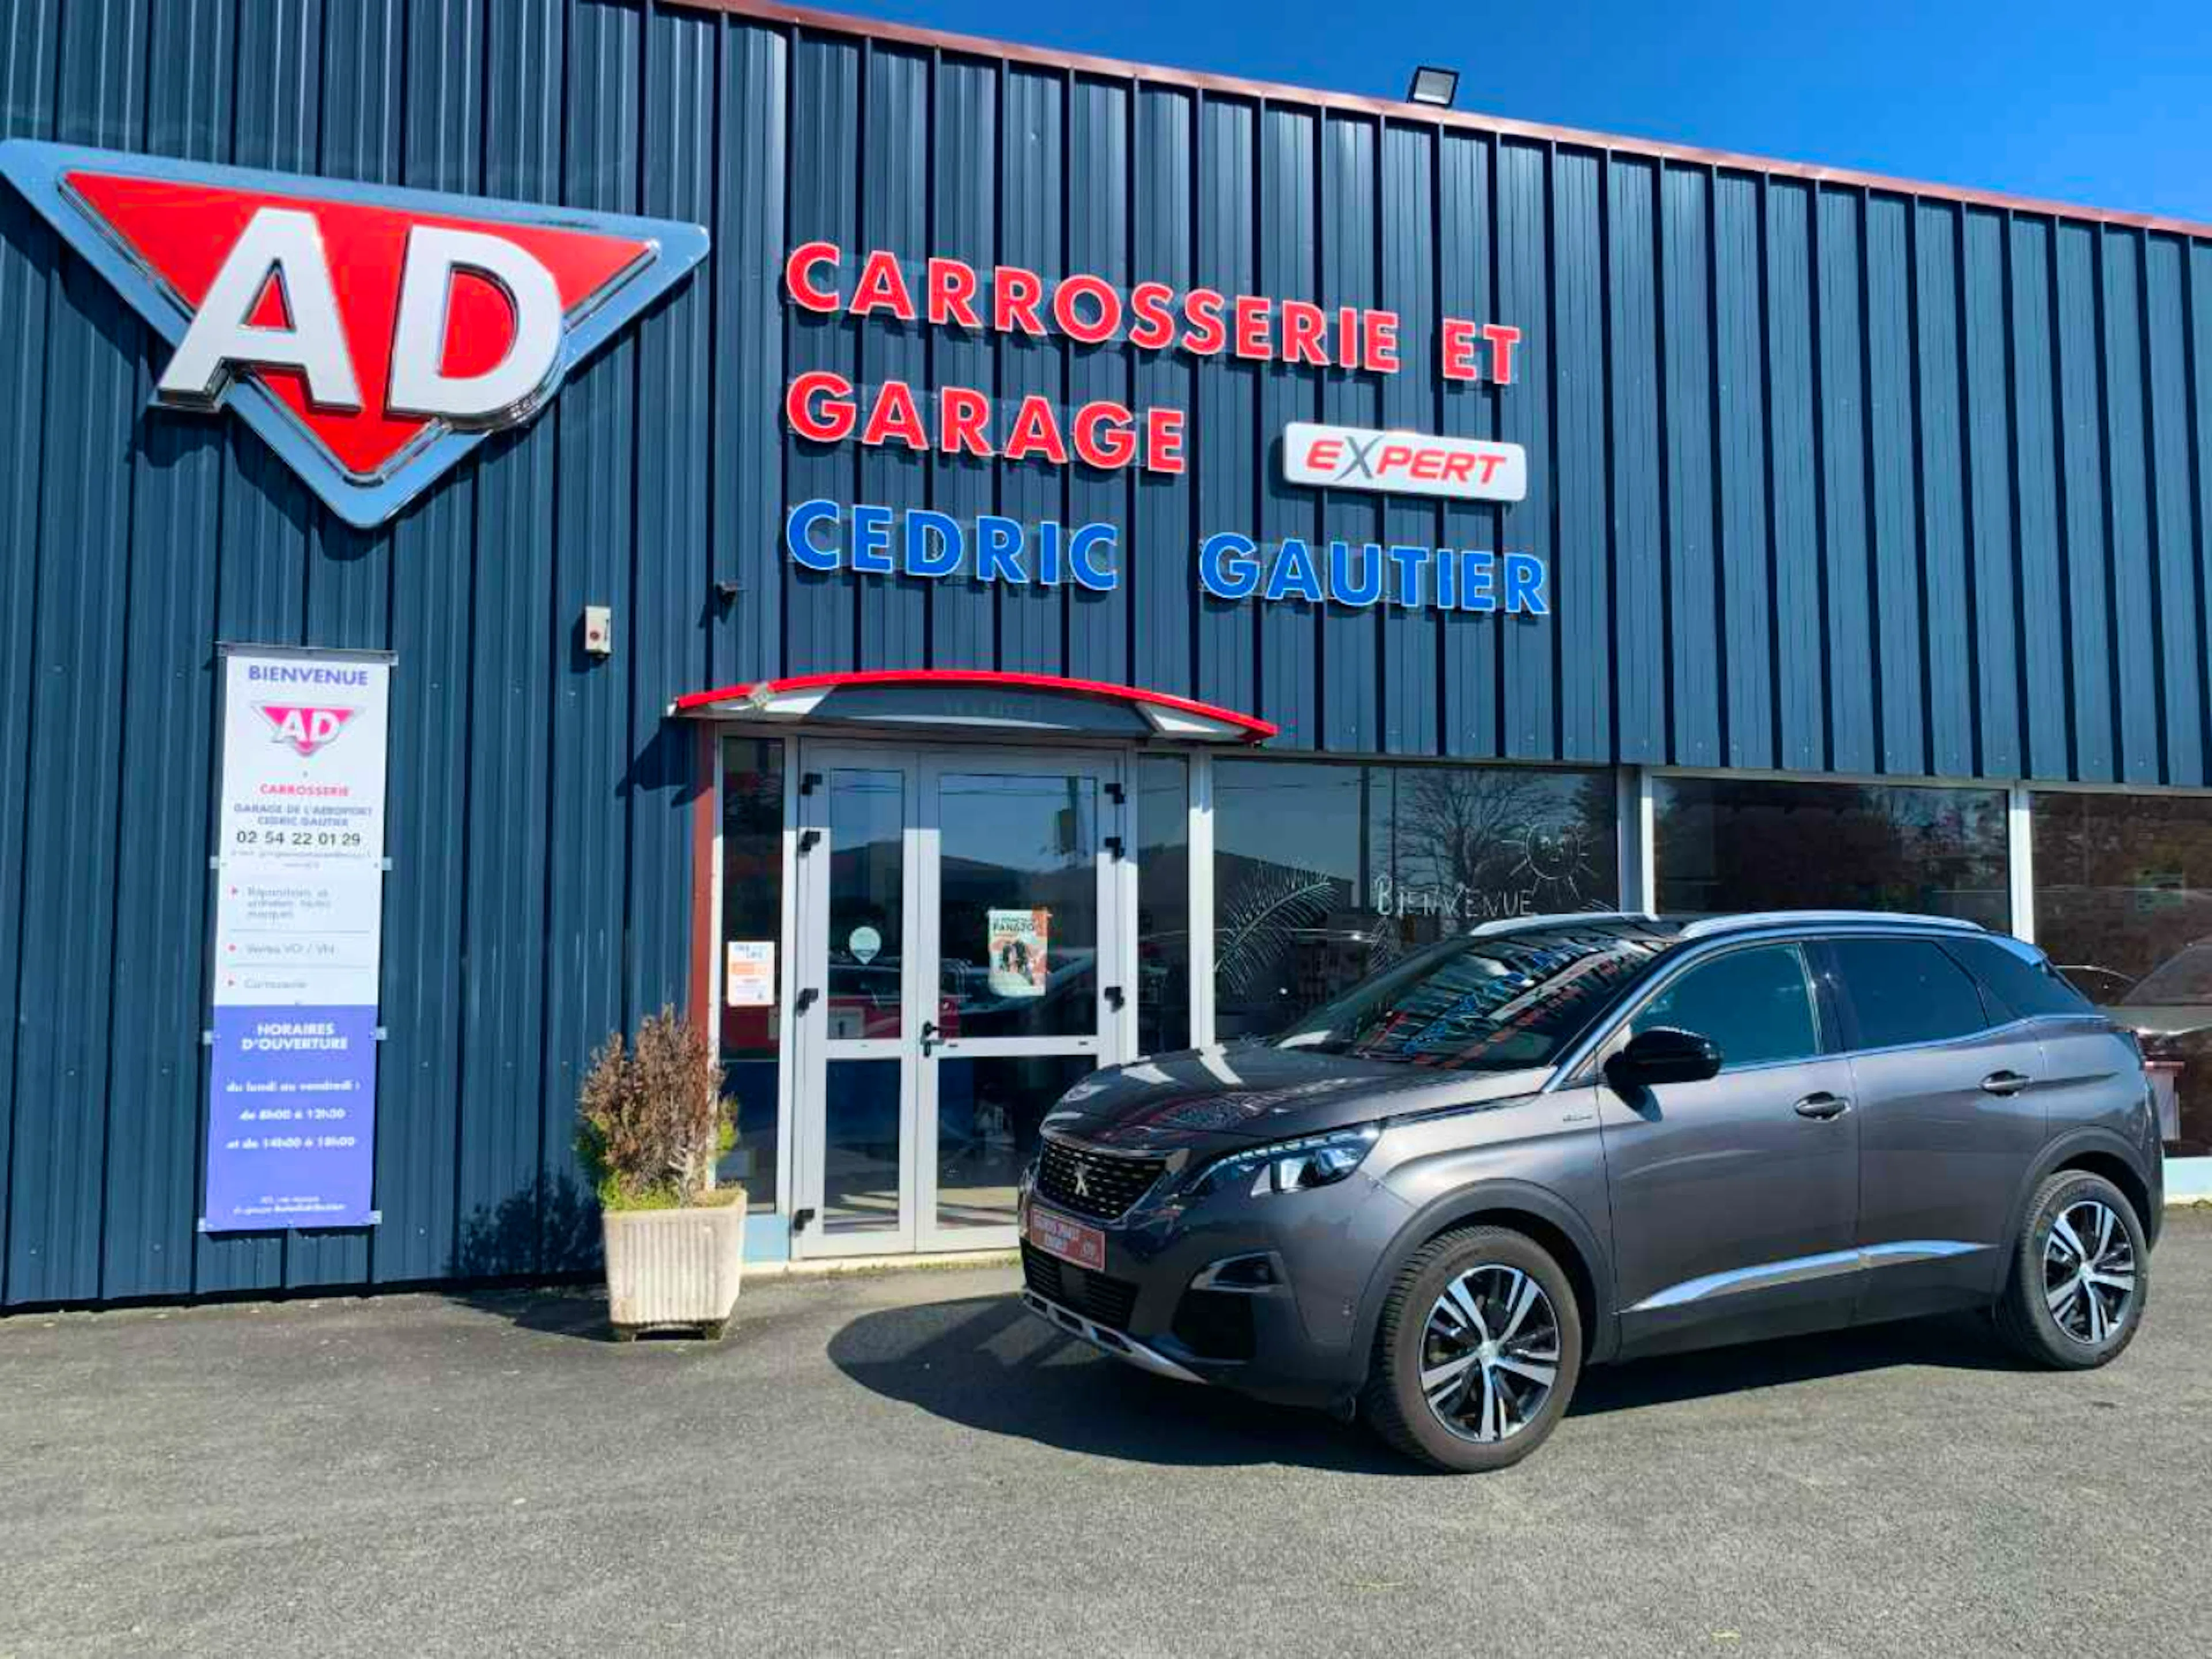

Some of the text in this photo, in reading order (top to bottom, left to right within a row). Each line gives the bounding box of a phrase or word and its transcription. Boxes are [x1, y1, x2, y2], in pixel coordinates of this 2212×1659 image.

[157, 206, 565, 414] AD
[786, 243, 1521, 384] CARROSSERIE ET
[786, 372, 1184, 474] GARAGE
[786, 499, 1548, 615] CEDRIC GAUTIER
[248, 665, 368, 685] BIENVENUE
[276, 708, 341, 744] AD
[259, 784, 349, 796] CARROSSERIE
[237, 831, 360, 846] 02 54 22 01 29
[257, 1022, 335, 1036] HORAIRES
[241, 1037, 348, 1051] D'OUVERTURE
[226, 1081, 243, 1092] du
[246, 1080, 278, 1092] lundi
